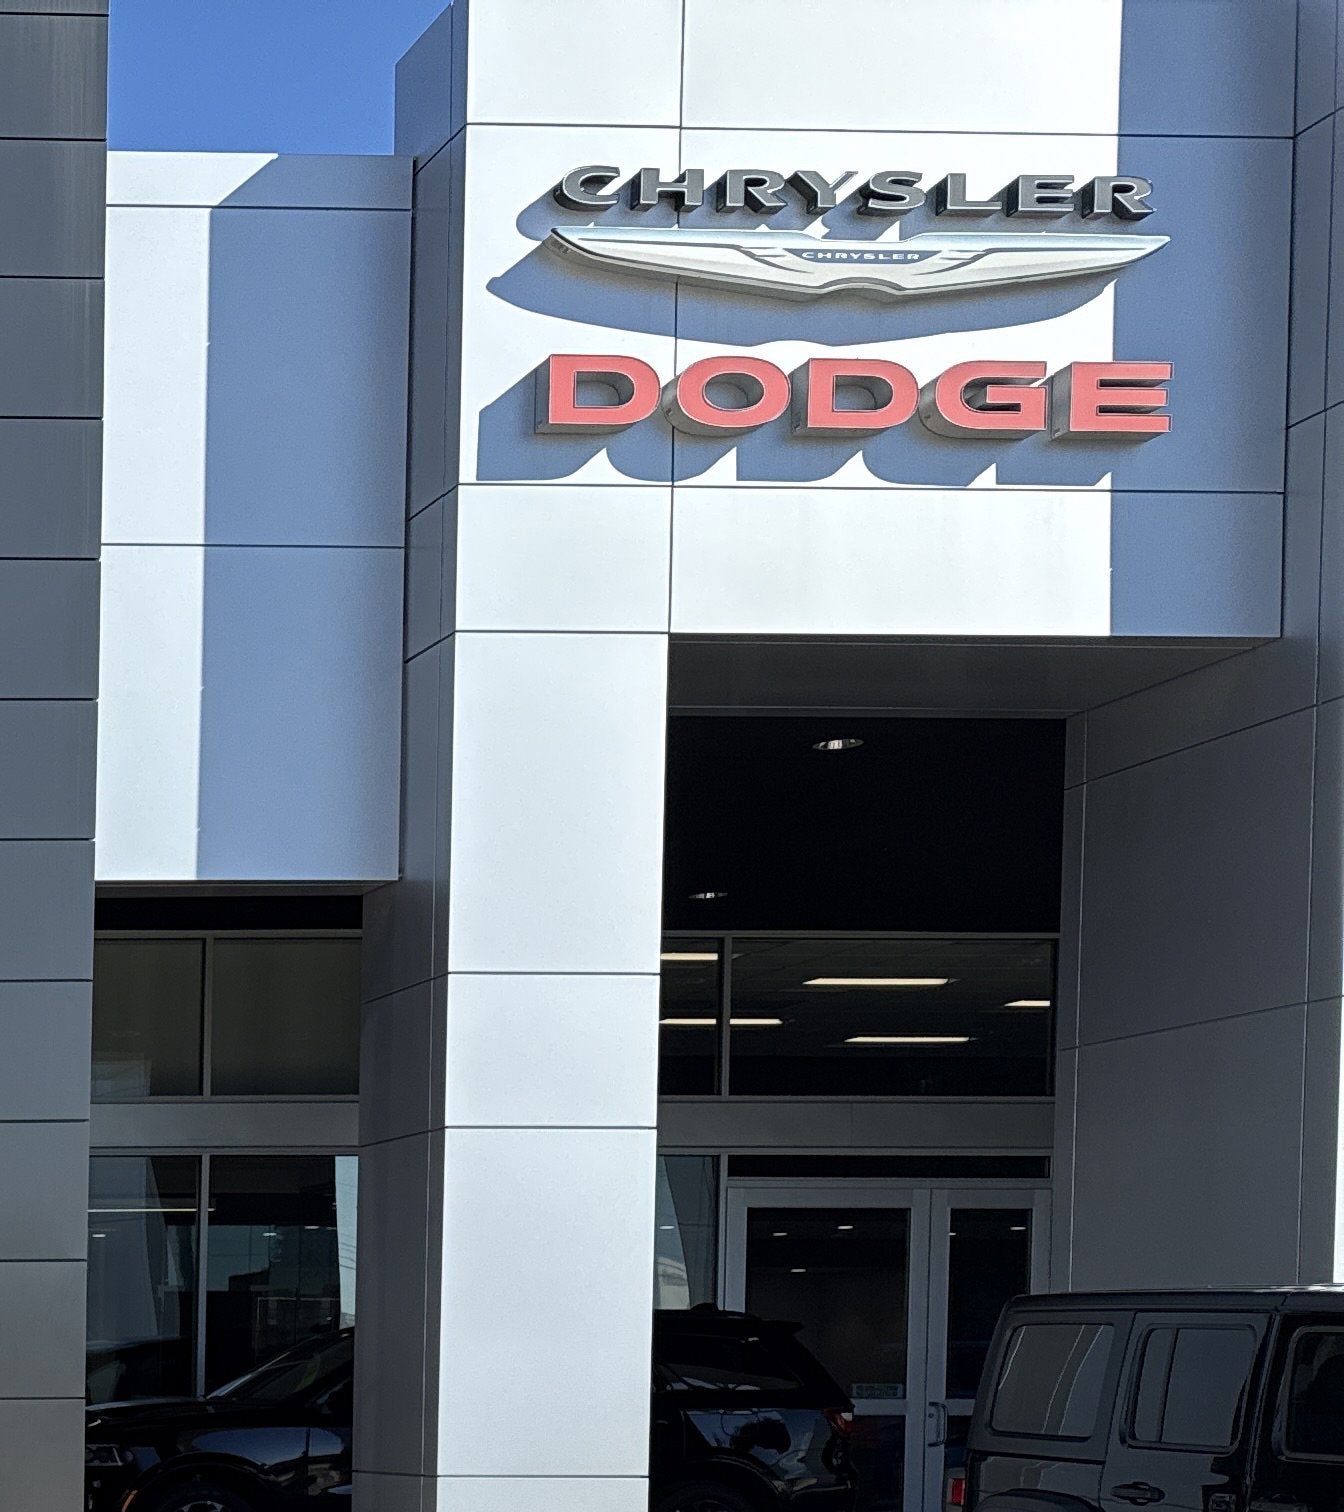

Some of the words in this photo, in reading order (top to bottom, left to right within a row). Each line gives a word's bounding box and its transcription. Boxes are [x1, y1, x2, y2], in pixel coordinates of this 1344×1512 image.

[558, 165, 1155, 214] CHRYSLER
[801, 251, 920, 261] CHRYSLER
[547, 354, 1173, 434] DODGE
